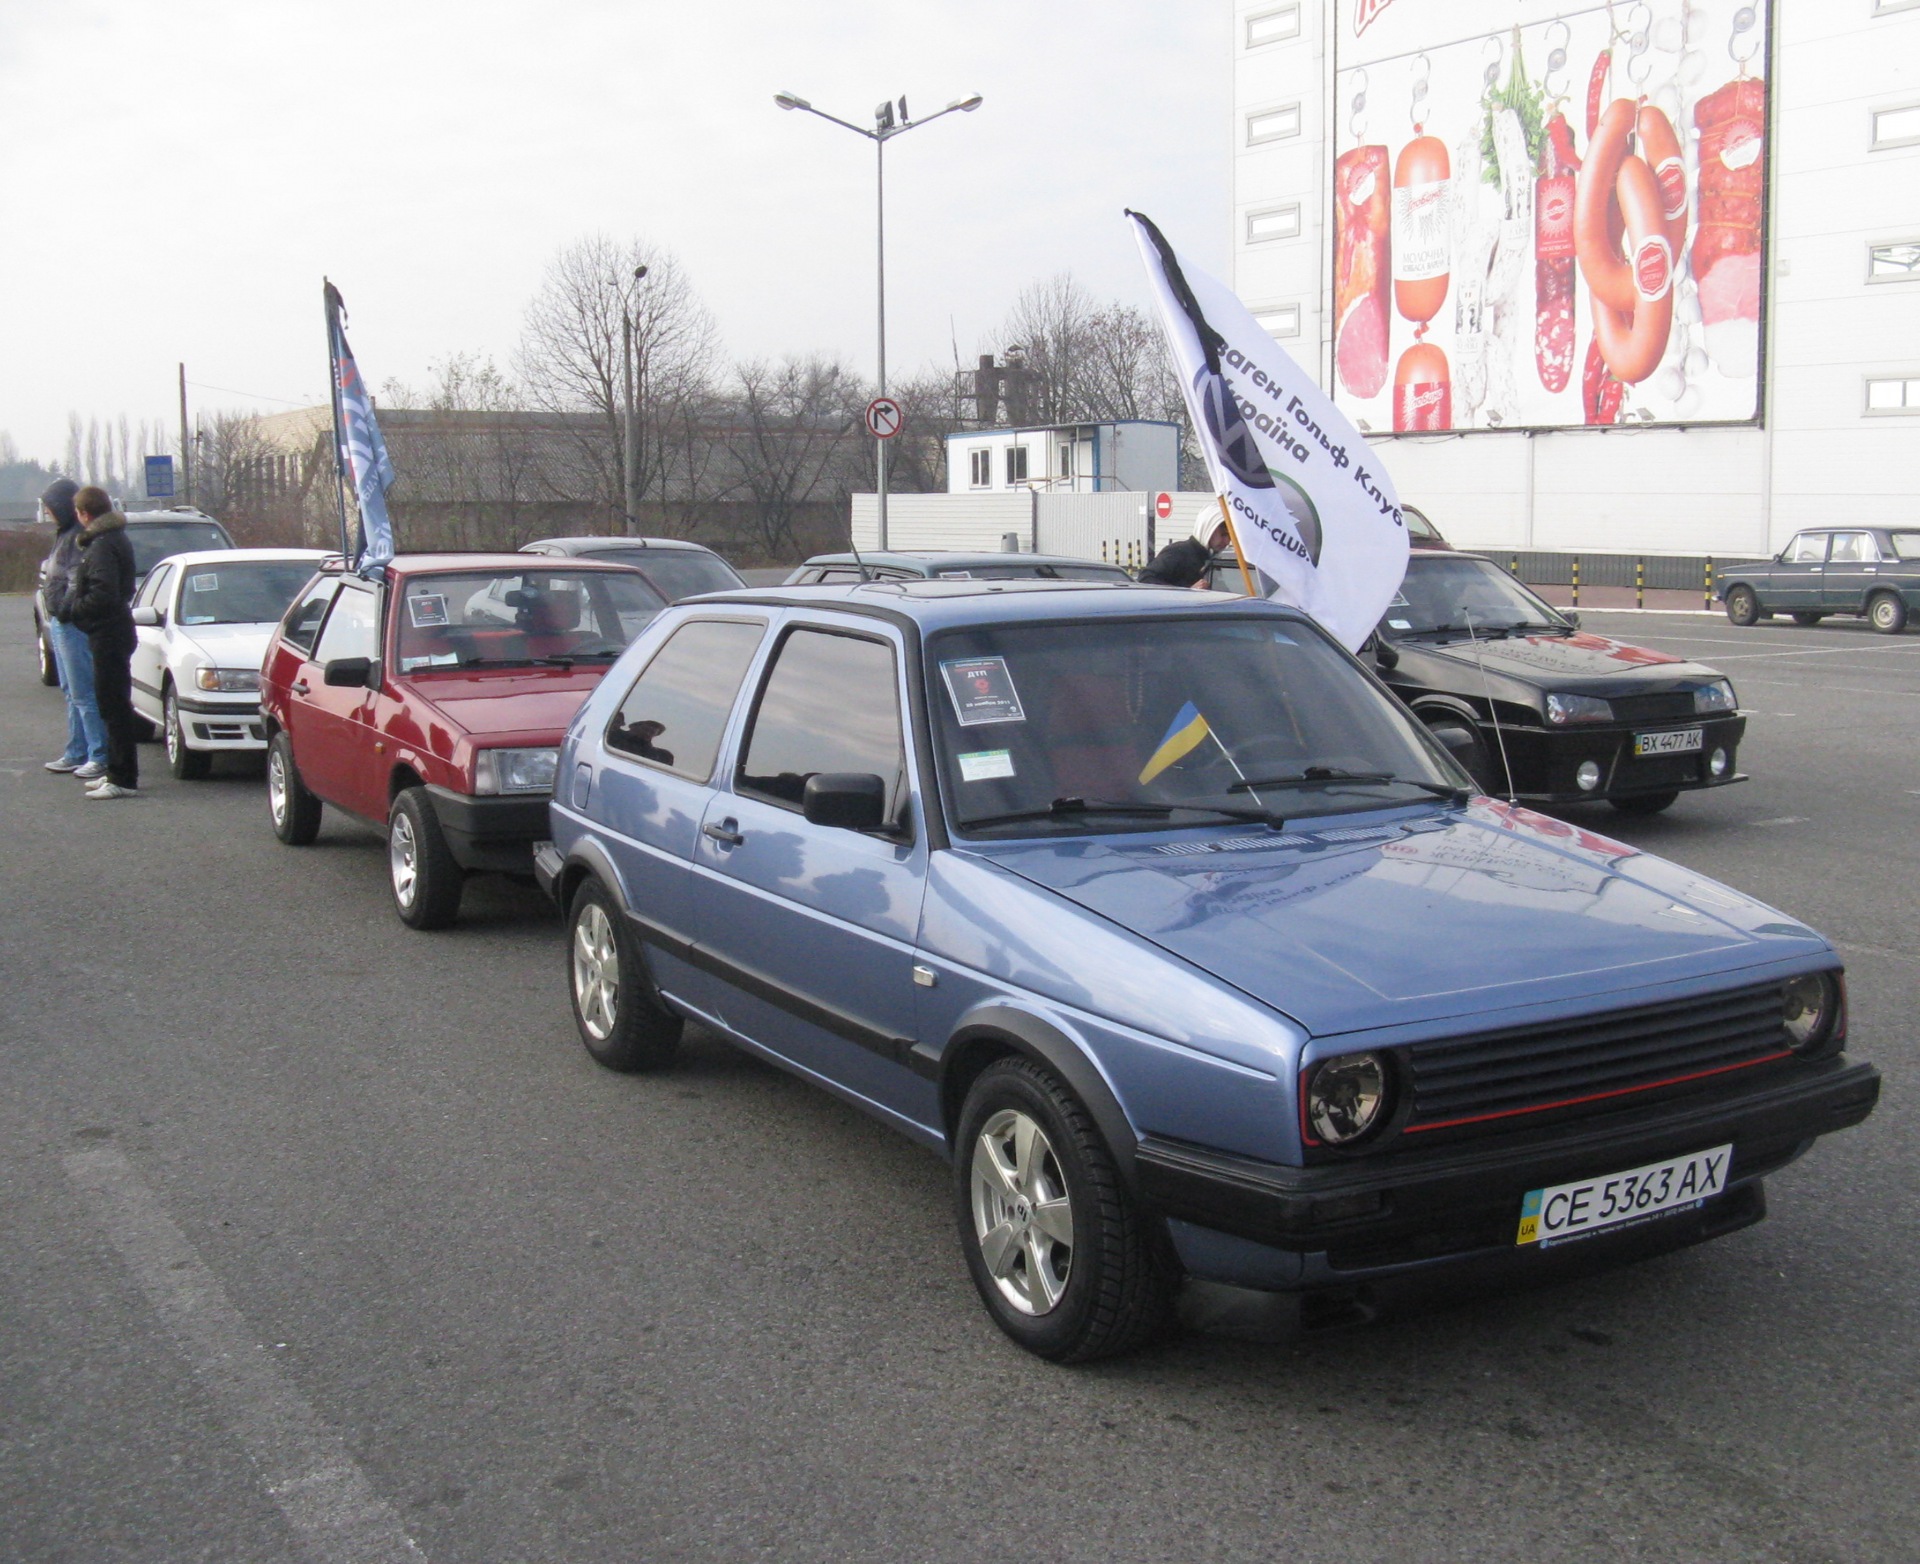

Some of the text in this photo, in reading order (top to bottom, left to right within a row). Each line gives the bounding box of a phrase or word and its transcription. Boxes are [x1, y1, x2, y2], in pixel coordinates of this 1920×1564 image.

[1286, 395, 1349, 468] Гольф
[1354, 465, 1402, 526] Клуб
[967, 670, 988, 678] ДТП
[1660, 733, 1684, 750] 4477
[1544, 1186, 1594, 1231] CE
[1598, 1167, 1675, 1218] 5363
[1676, 1153, 1724, 1198] AX
[1521, 1224, 1536, 1235] UA
